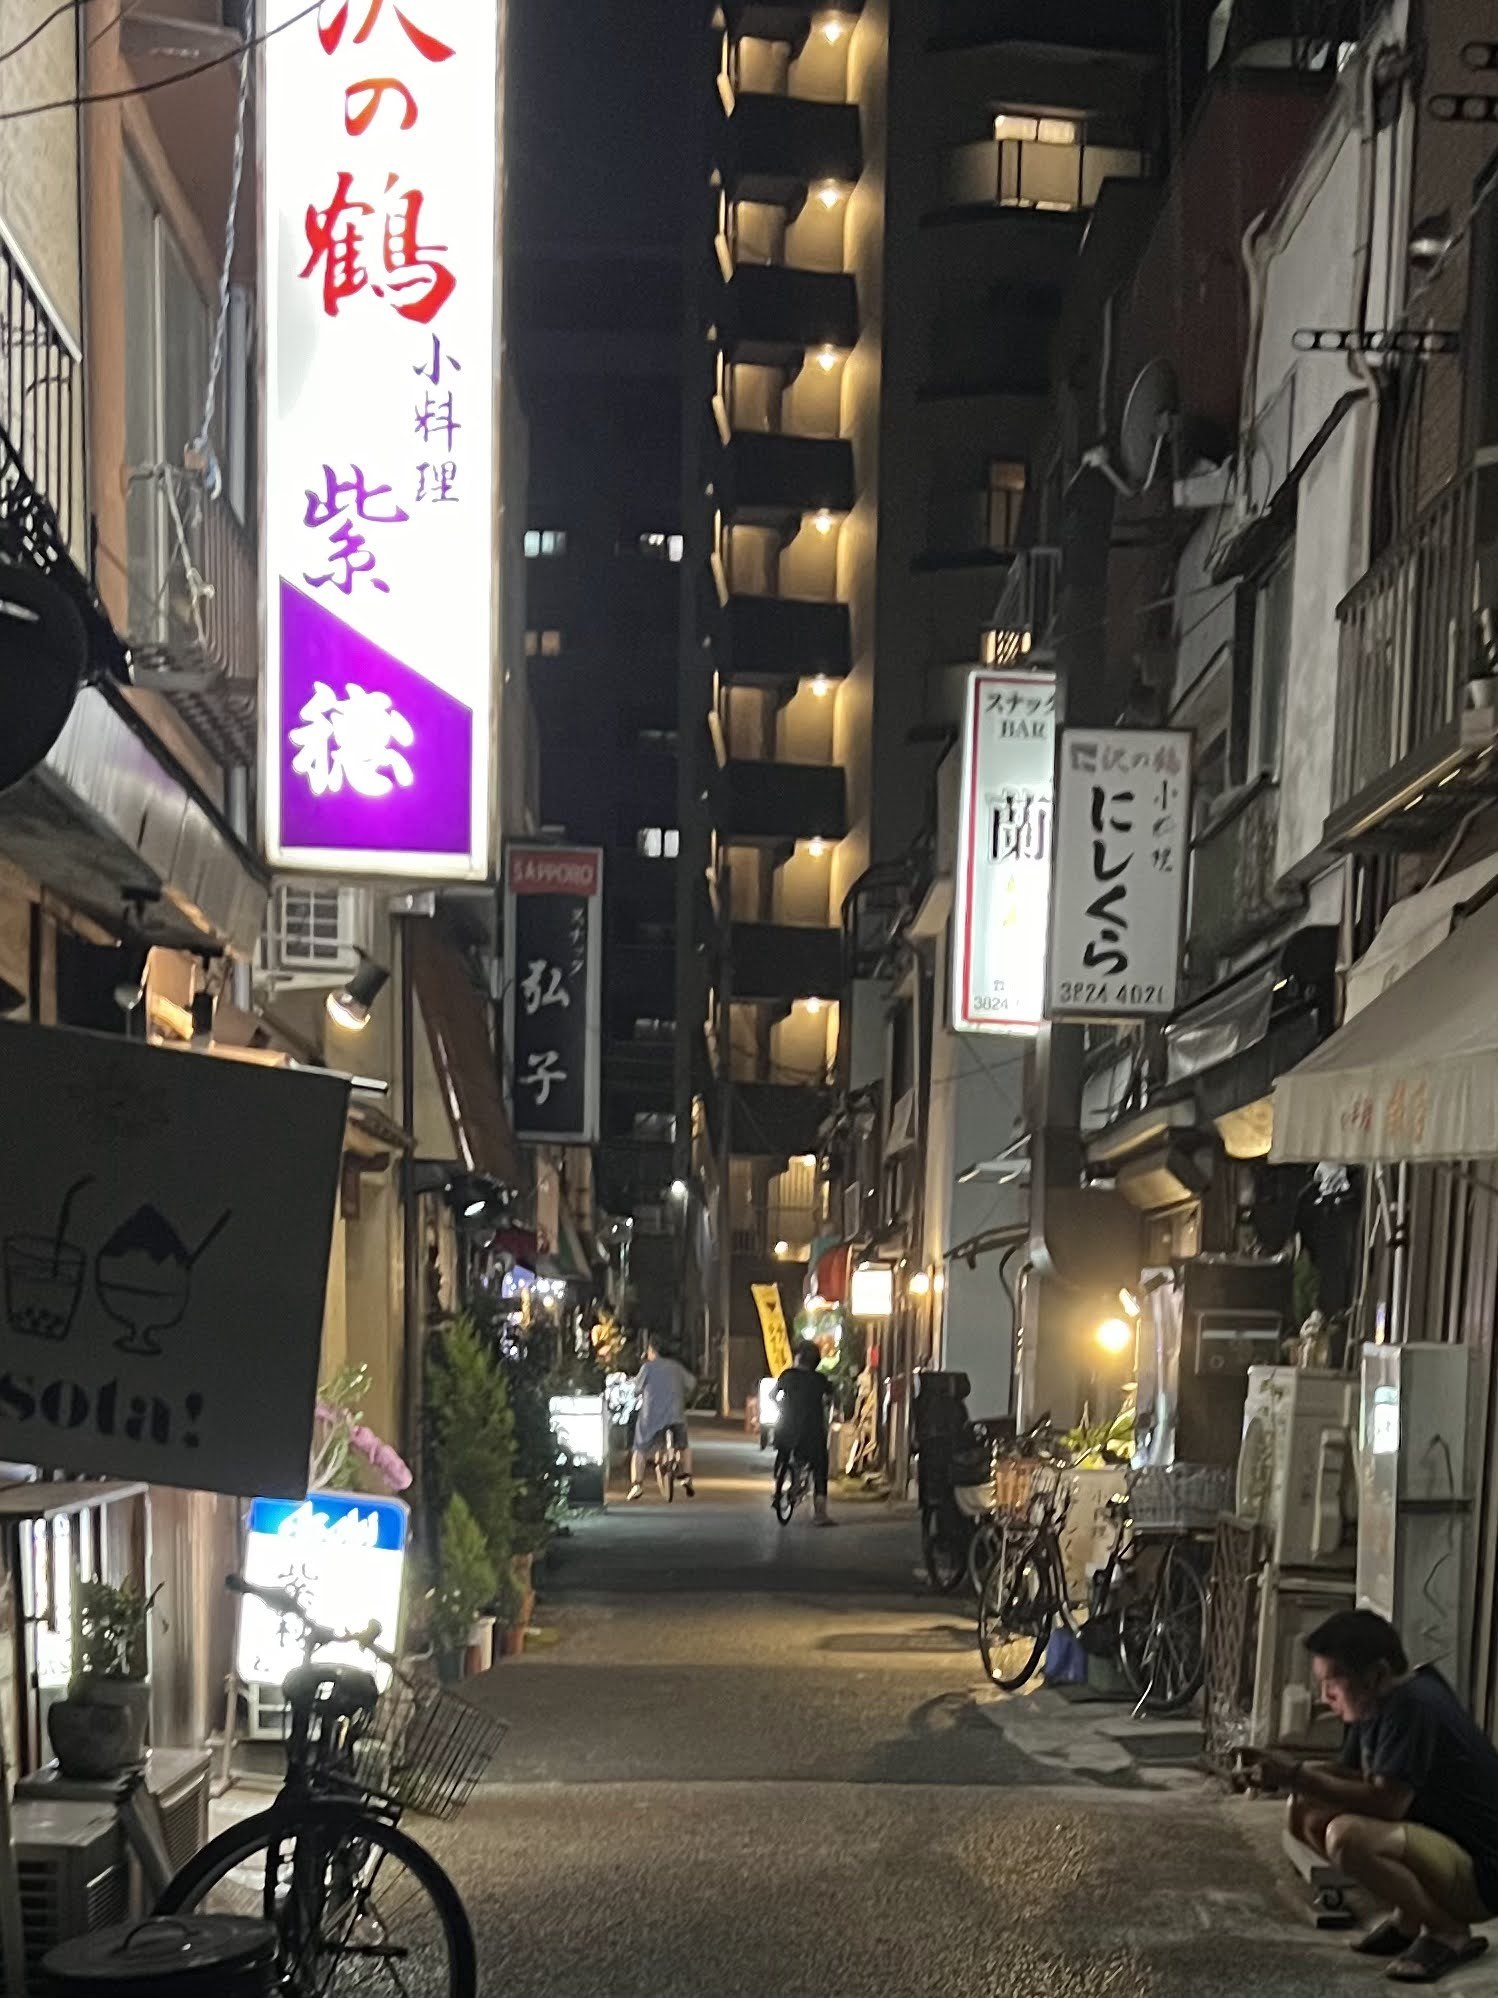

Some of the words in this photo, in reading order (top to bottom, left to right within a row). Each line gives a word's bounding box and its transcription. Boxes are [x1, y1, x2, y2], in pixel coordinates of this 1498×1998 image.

[412, 333, 462, 502] 小料理
[1000, 719, 1048, 739] BAR
[512, 860, 594, 886] SAPPORO
[1082, 785, 1136, 976] にしくら
[517, 958, 571, 1106] 弘子
